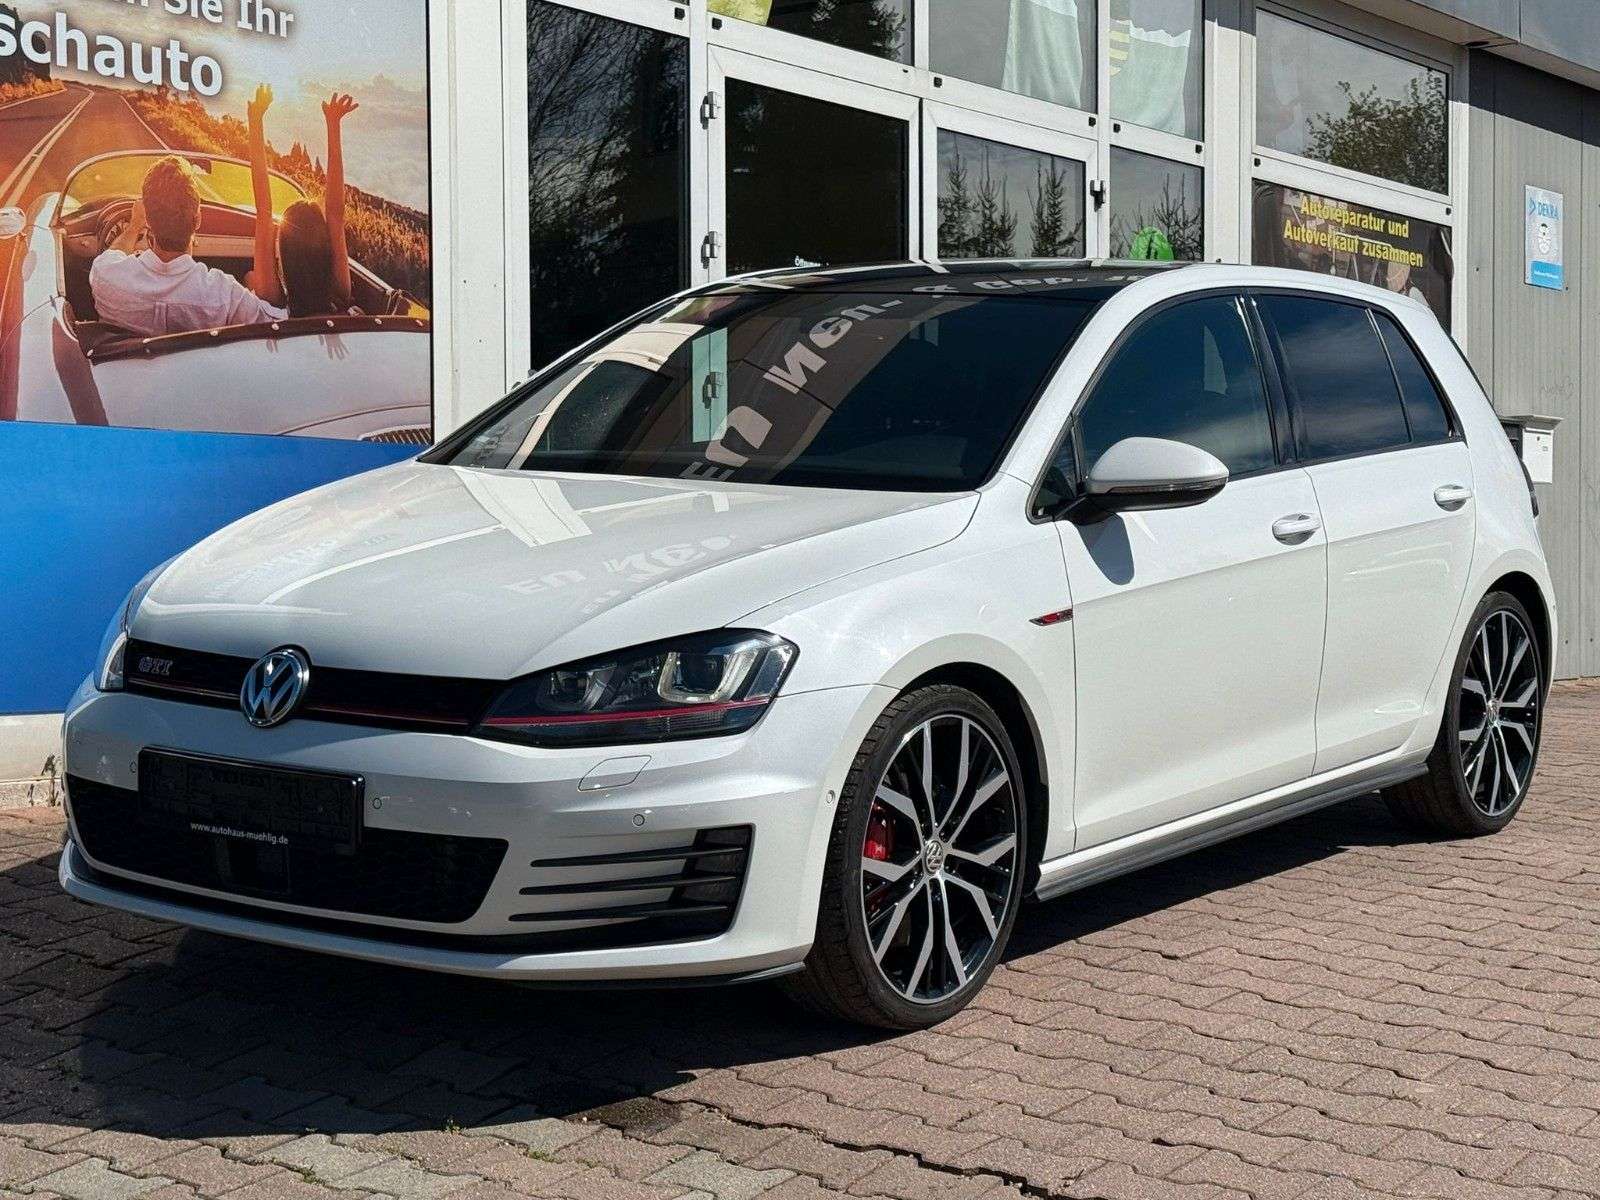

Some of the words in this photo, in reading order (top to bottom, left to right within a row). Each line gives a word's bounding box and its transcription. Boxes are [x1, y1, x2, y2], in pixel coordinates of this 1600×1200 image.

[236, 0, 294, 38] Ihr
[0, 11, 223, 96] schauto
[1300, 193, 1385, 233] Autoreparatur
[1388, 219, 1410, 238] und
[1284, 219, 1360, 254] Autoverkauf
[1362, 240, 1424, 268] zusammen
[138, 656, 174, 676] GTI
[243, 651, 302, 724] VW
[190, 822, 288, 844] www.autohaus-muehlig.de
